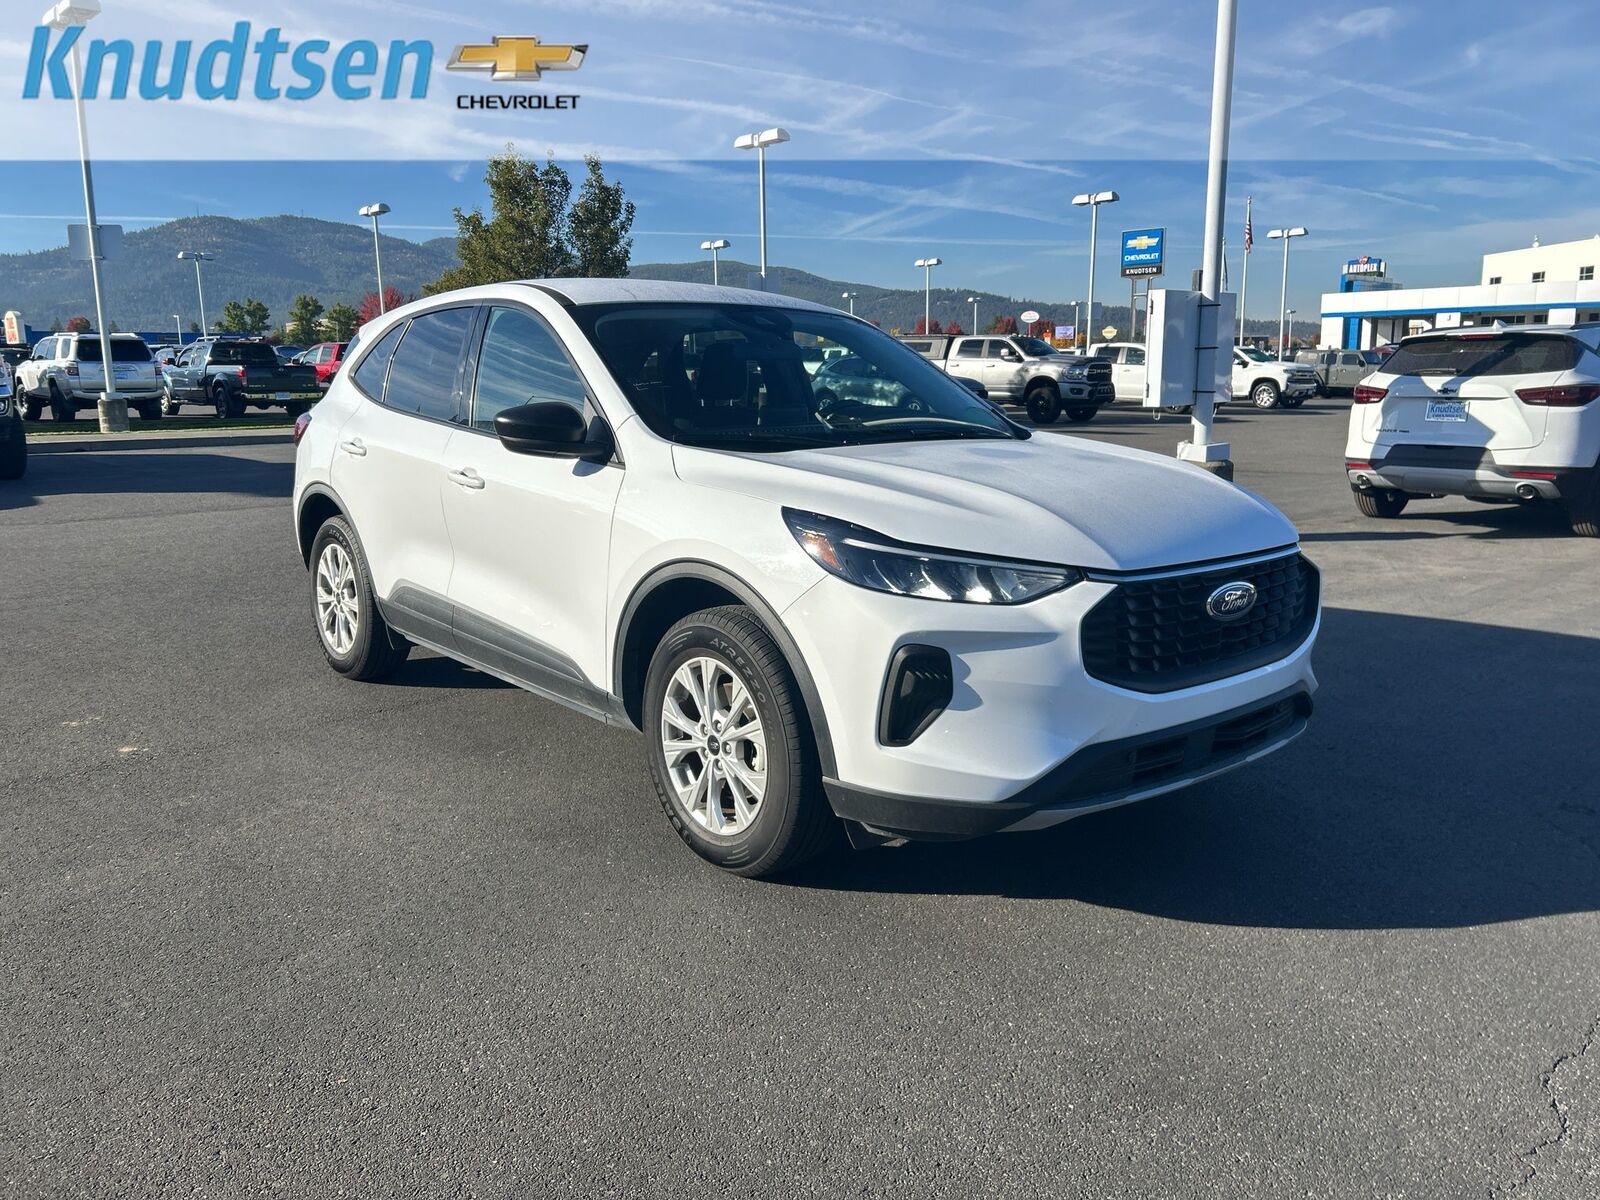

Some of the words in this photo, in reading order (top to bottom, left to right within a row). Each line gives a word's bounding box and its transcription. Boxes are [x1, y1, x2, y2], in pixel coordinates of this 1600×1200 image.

[1124, 252, 1159, 261] CHEVROLET
[1125, 267, 1157, 275] KNUDTSEN
[1221, 590, 1249, 611] Ford
[710, 638, 766, 703] ATREZZO
